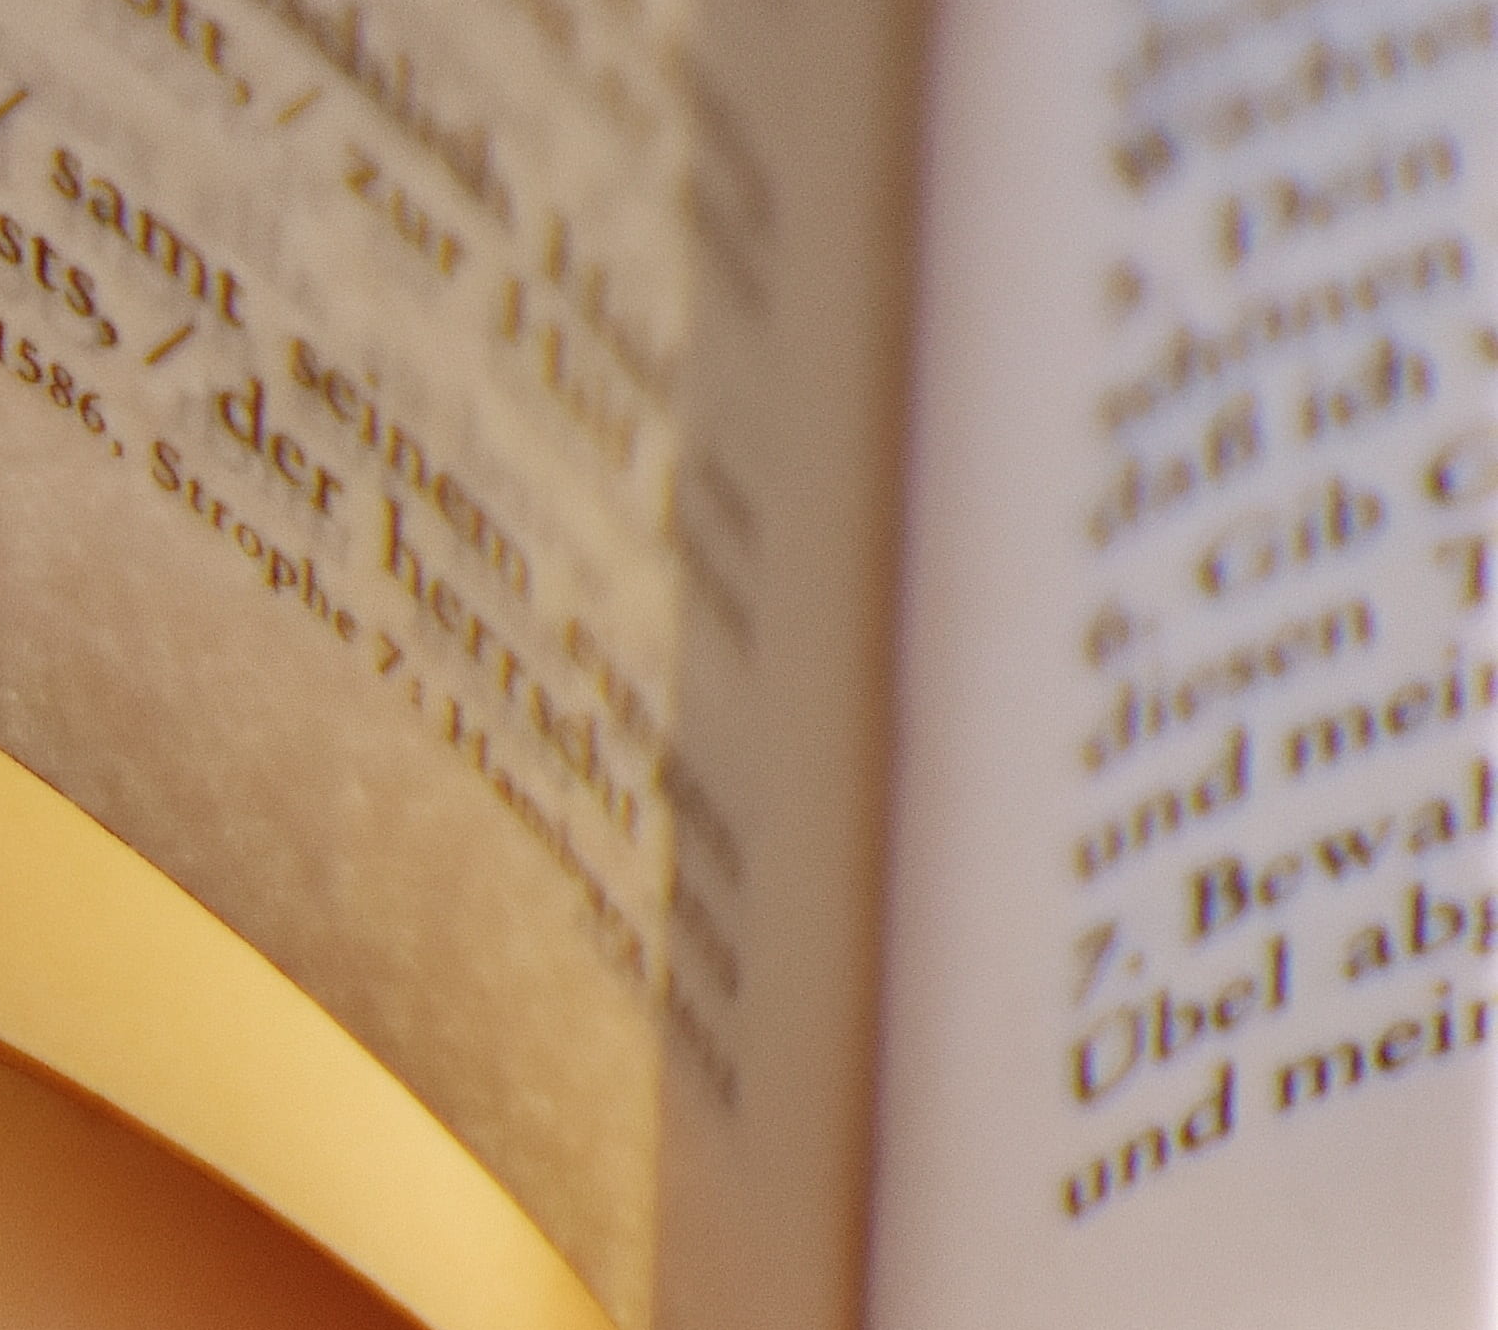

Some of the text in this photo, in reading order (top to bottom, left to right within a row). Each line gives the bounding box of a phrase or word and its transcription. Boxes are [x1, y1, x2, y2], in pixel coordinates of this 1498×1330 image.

[52, 147, 245, 329] samt
[291, 338, 530, 601] seinem
[213, 378, 347, 518] der
[149, 439, 359, 644] Strophe
[1196, 475, 1388, 599] Gib
[1073, 725, 1250, 882] und
[1059, 1063, 1236, 1221] und
